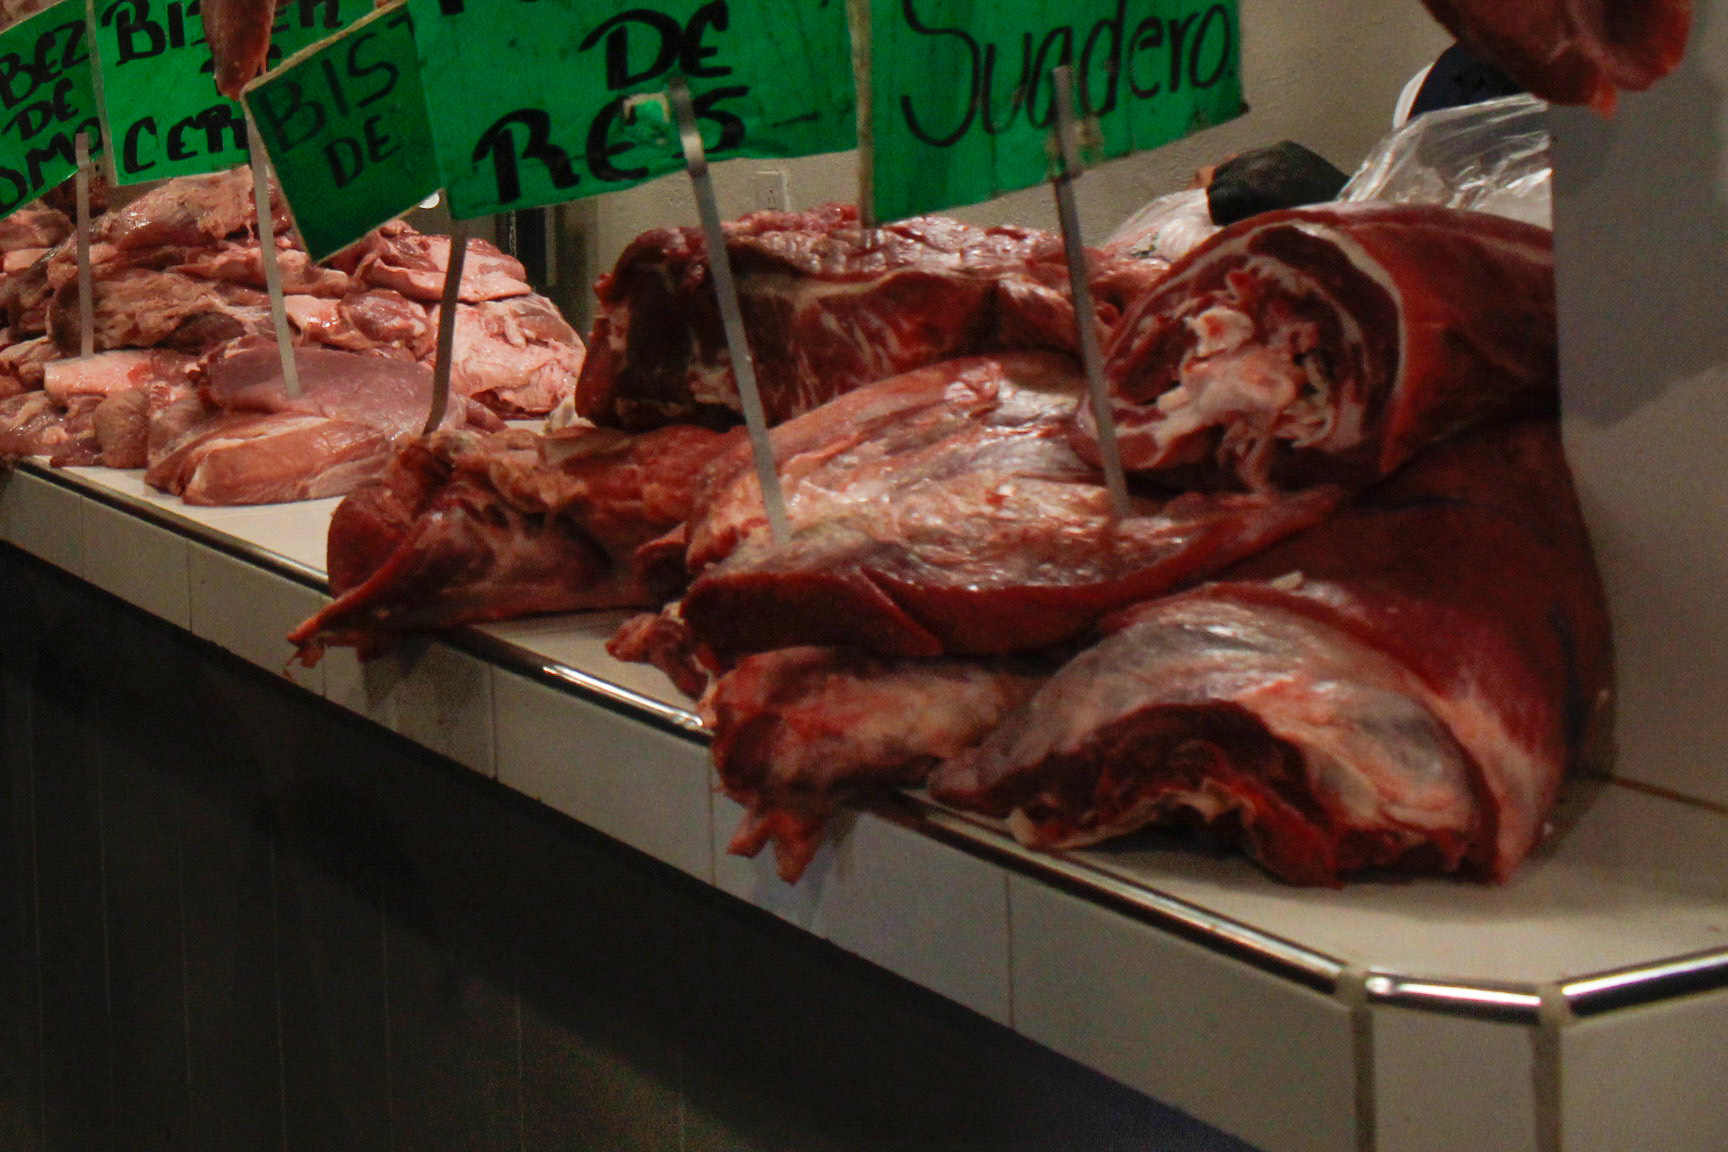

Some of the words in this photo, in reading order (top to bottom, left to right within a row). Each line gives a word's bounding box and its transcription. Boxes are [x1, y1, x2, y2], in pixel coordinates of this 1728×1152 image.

[579, 0, 732, 90] DE
[1, 78, 80, 141] DE
[473, 86, 749, 203] RES
[326, 115, 402, 188] DE
